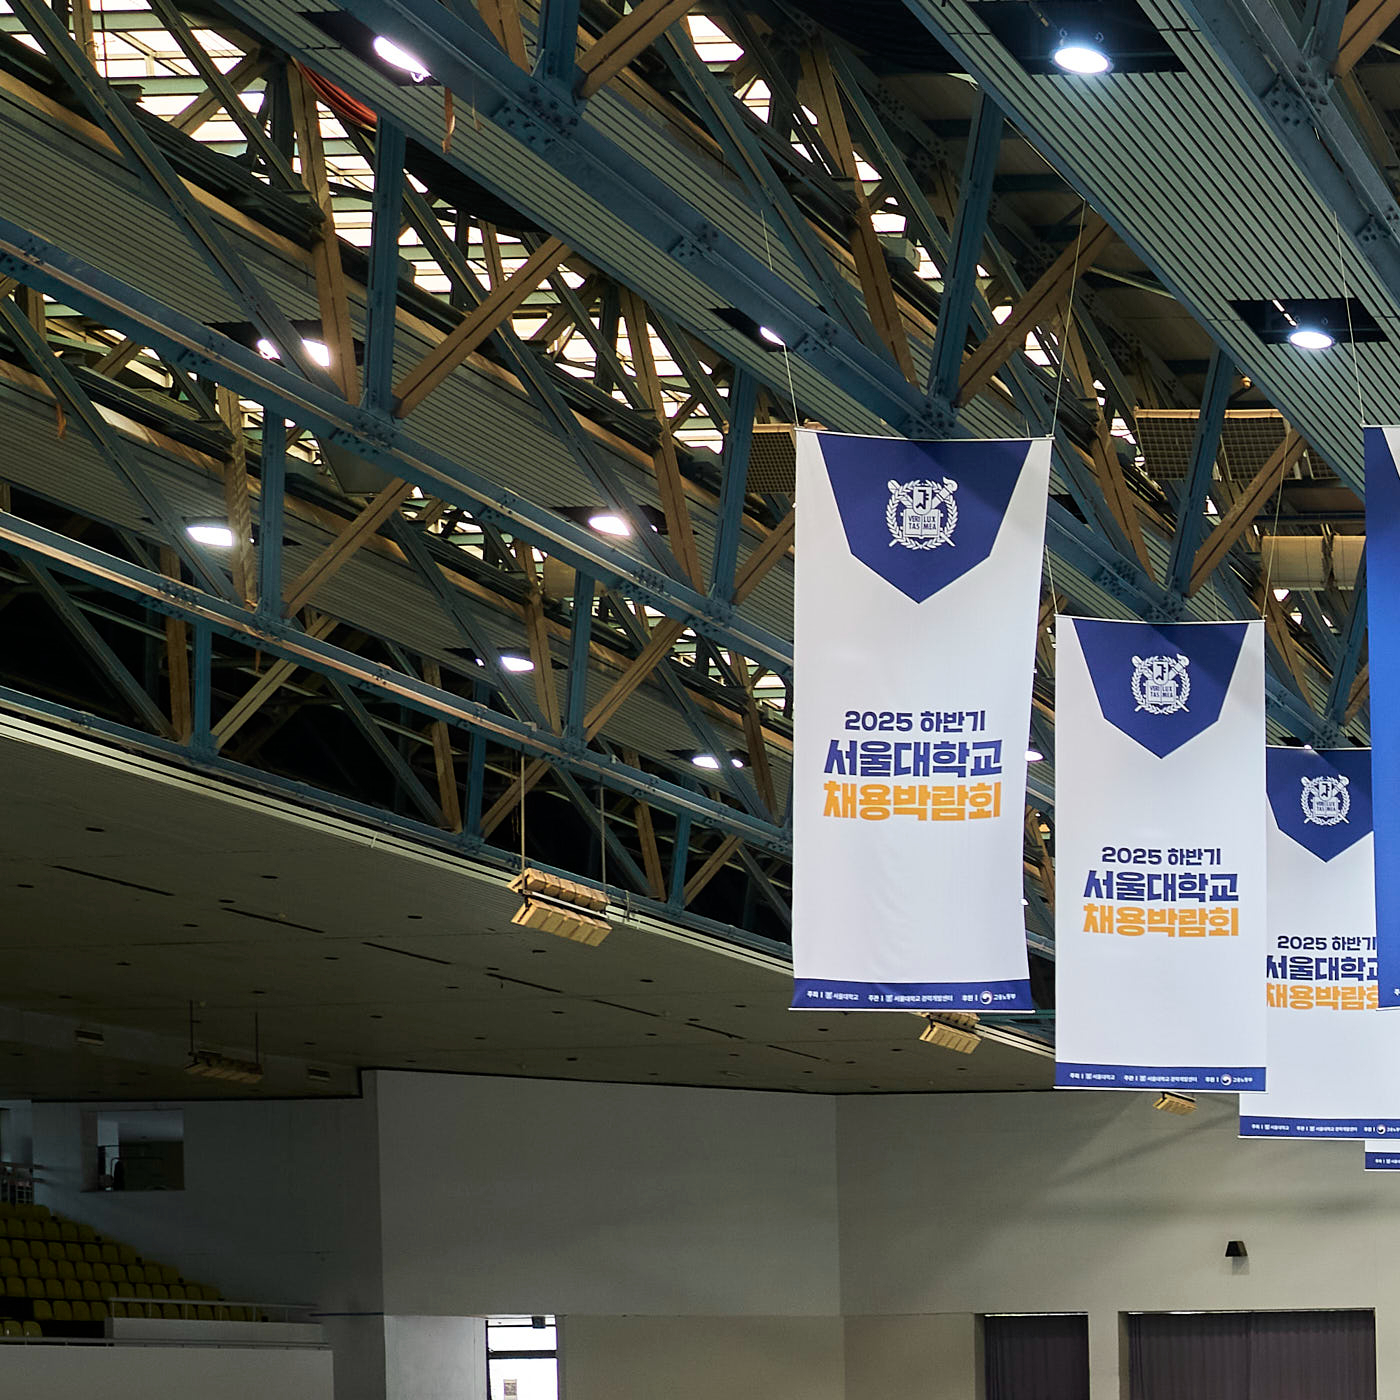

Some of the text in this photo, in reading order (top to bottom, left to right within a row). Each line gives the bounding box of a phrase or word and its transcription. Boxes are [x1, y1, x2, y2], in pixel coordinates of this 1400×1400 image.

[844, 710, 986, 734] 2025 하반기
[823, 739, 1003, 779] 서울대학교
[823, 781, 1001, 822] 채용박람회
